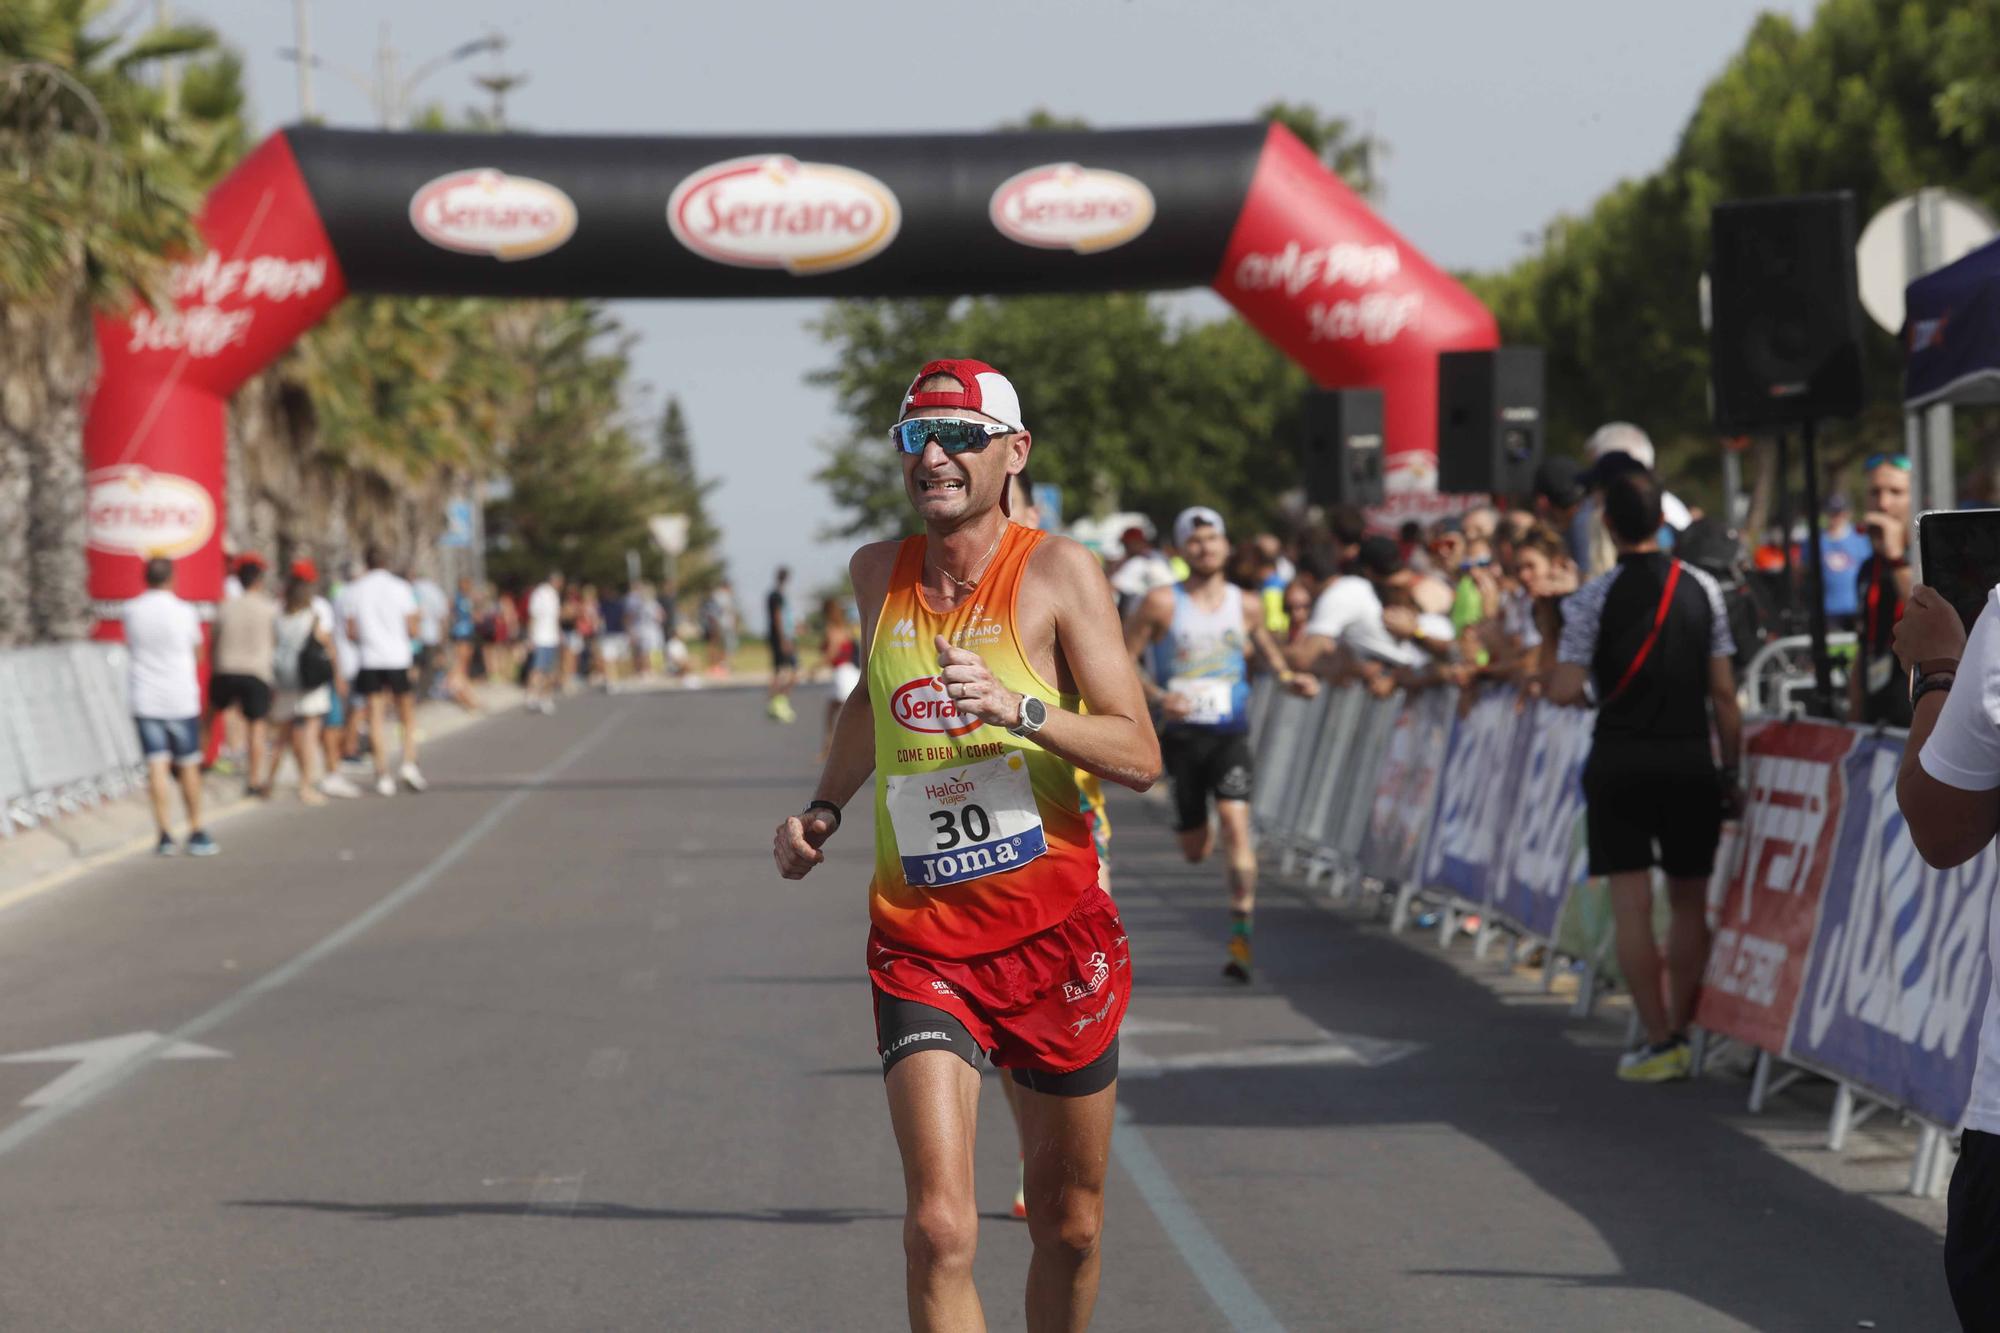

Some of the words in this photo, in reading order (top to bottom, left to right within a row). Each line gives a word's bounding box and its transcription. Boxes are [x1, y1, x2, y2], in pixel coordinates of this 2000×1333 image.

[433, 192, 556, 230] Serrano
[703, 190, 873, 236] Serrano
[1012, 192, 1133, 225] Serrano
[88, 505, 200, 526] errano
[900, 693, 967, 720] Serra
[897, 748, 925, 763] COME
[926, 746, 954, 761] BIEN
[955, 746, 963, 760] Y
[966, 742, 1005, 759] CORRE
[939, 793, 967, 806] viajes
[929, 804, 990, 850] 30
[892, 1031, 952, 1052] LURBEL
